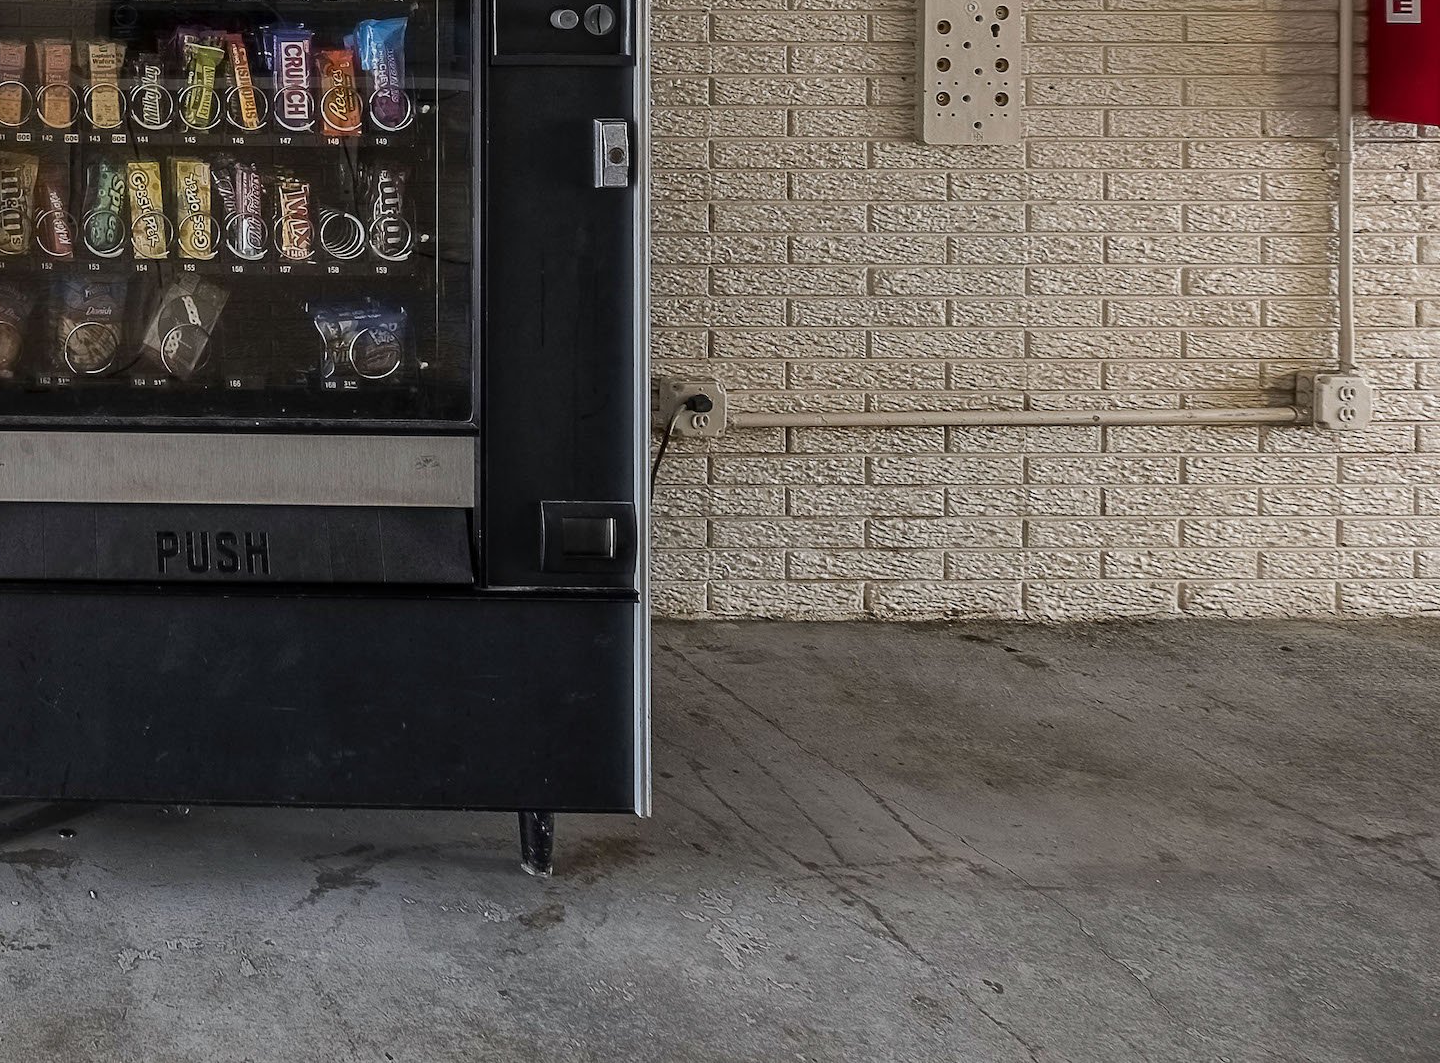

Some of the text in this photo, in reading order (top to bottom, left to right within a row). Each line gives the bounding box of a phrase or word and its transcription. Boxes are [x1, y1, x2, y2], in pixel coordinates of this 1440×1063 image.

[284, 44, 306, 116] CRUNCH
[142, 90, 162, 125] Milky
[86, 306, 112, 316] Danish
[156, 530, 272, 577] PUSH
